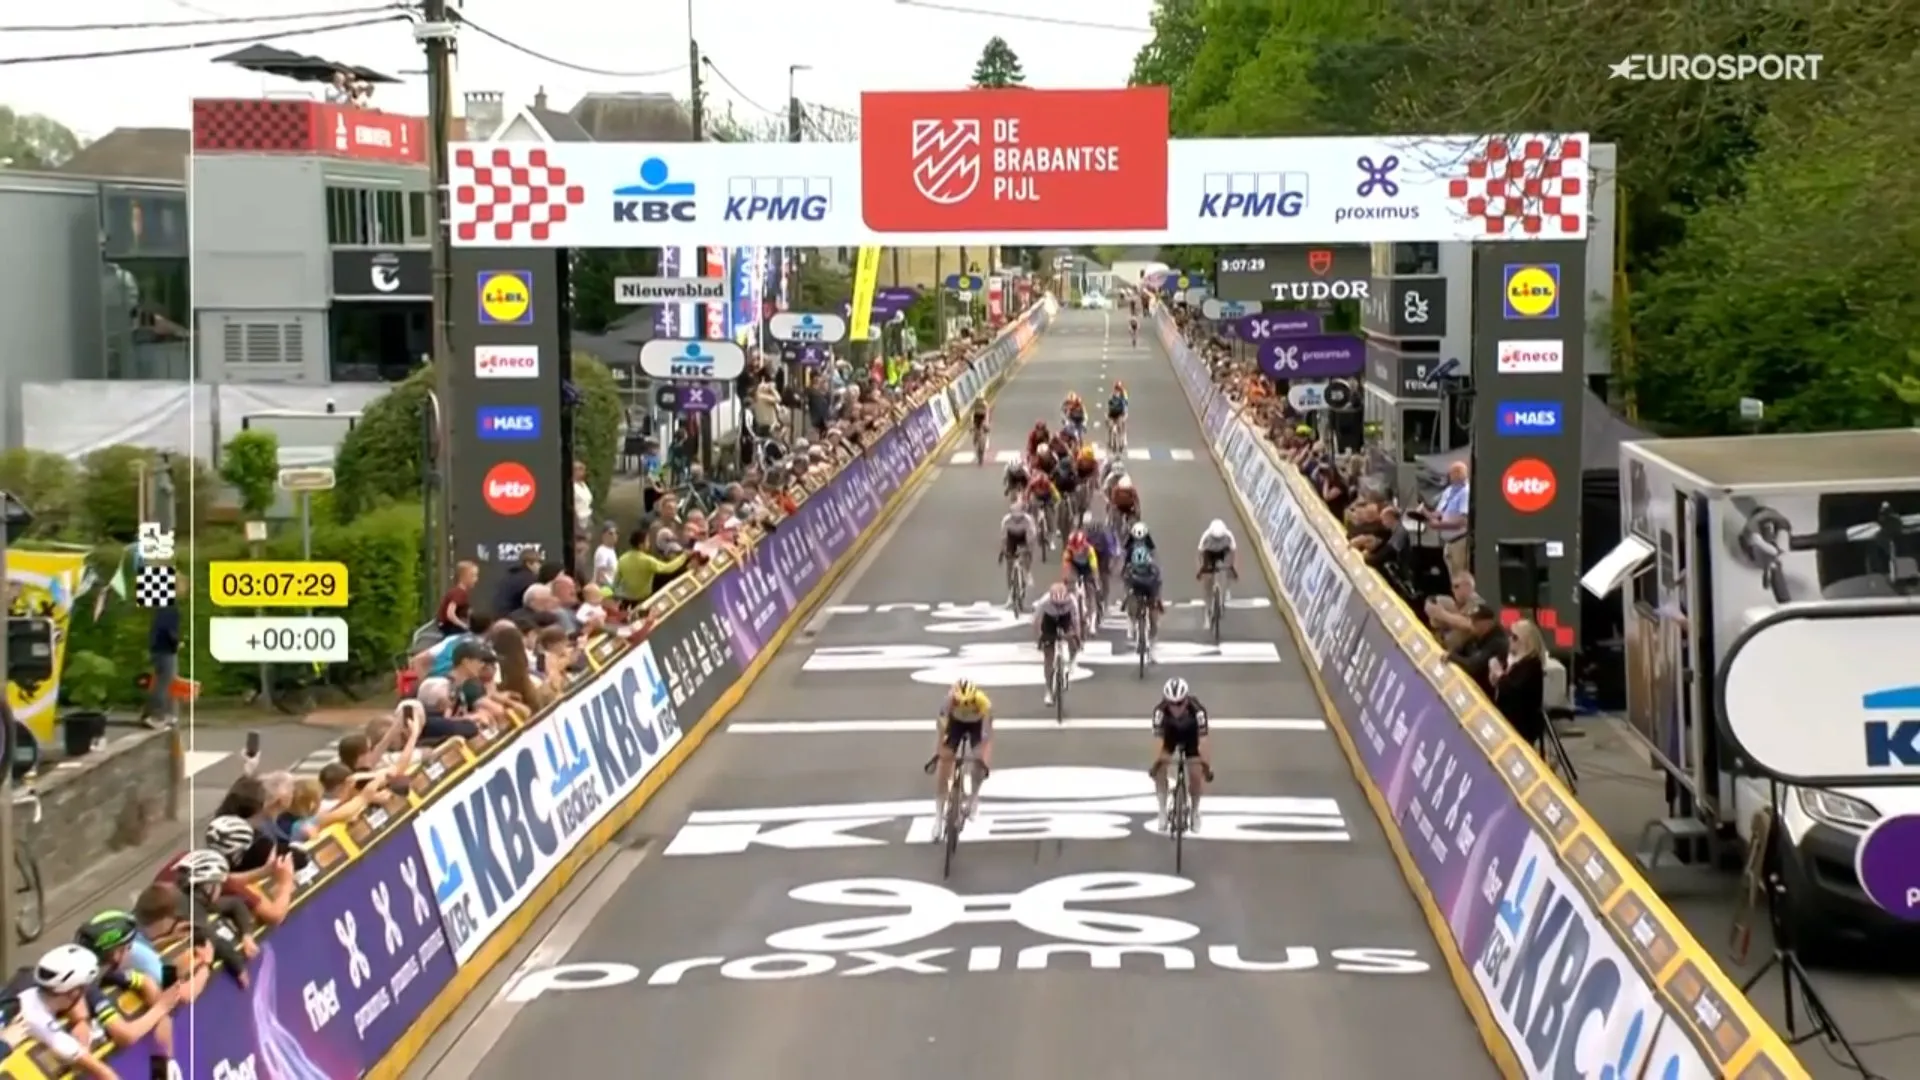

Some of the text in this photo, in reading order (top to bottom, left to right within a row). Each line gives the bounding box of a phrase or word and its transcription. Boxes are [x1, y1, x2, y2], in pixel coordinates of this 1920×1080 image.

[993, 118, 1020, 144] DE
[993, 145, 1120, 173] BRABANTSE
[993, 175, 1041, 201] PIJL
[613, 200, 697, 223] KBC
[723, 195, 828, 222] KPMG
[1198, 191, 1304, 219] KPMG
[1334, 204, 1421, 225] proximus
[1221, 258, 1266, 272] 3:07:29
[621, 282, 725, 299] Nieuwsblad
[1271, 279, 1370, 300] TUDOR
[489, 355, 535, 368] Eneco
[1512, 350, 1559, 363] Eneco
[669, 364, 715, 377] KBC
[493, 416, 534, 431] MAES
[1514, 411, 1557, 426] MAES
[488, 480, 531, 498] lotto
[1506, 477, 1552, 496] lotto
[580, 666, 660, 796] KBC
[452, 747, 560, 918] KBC
[662, 813, 1352, 856] KBC
[506, 942, 1431, 1002] proximus
[1500, 876, 1622, 1080] KBC
